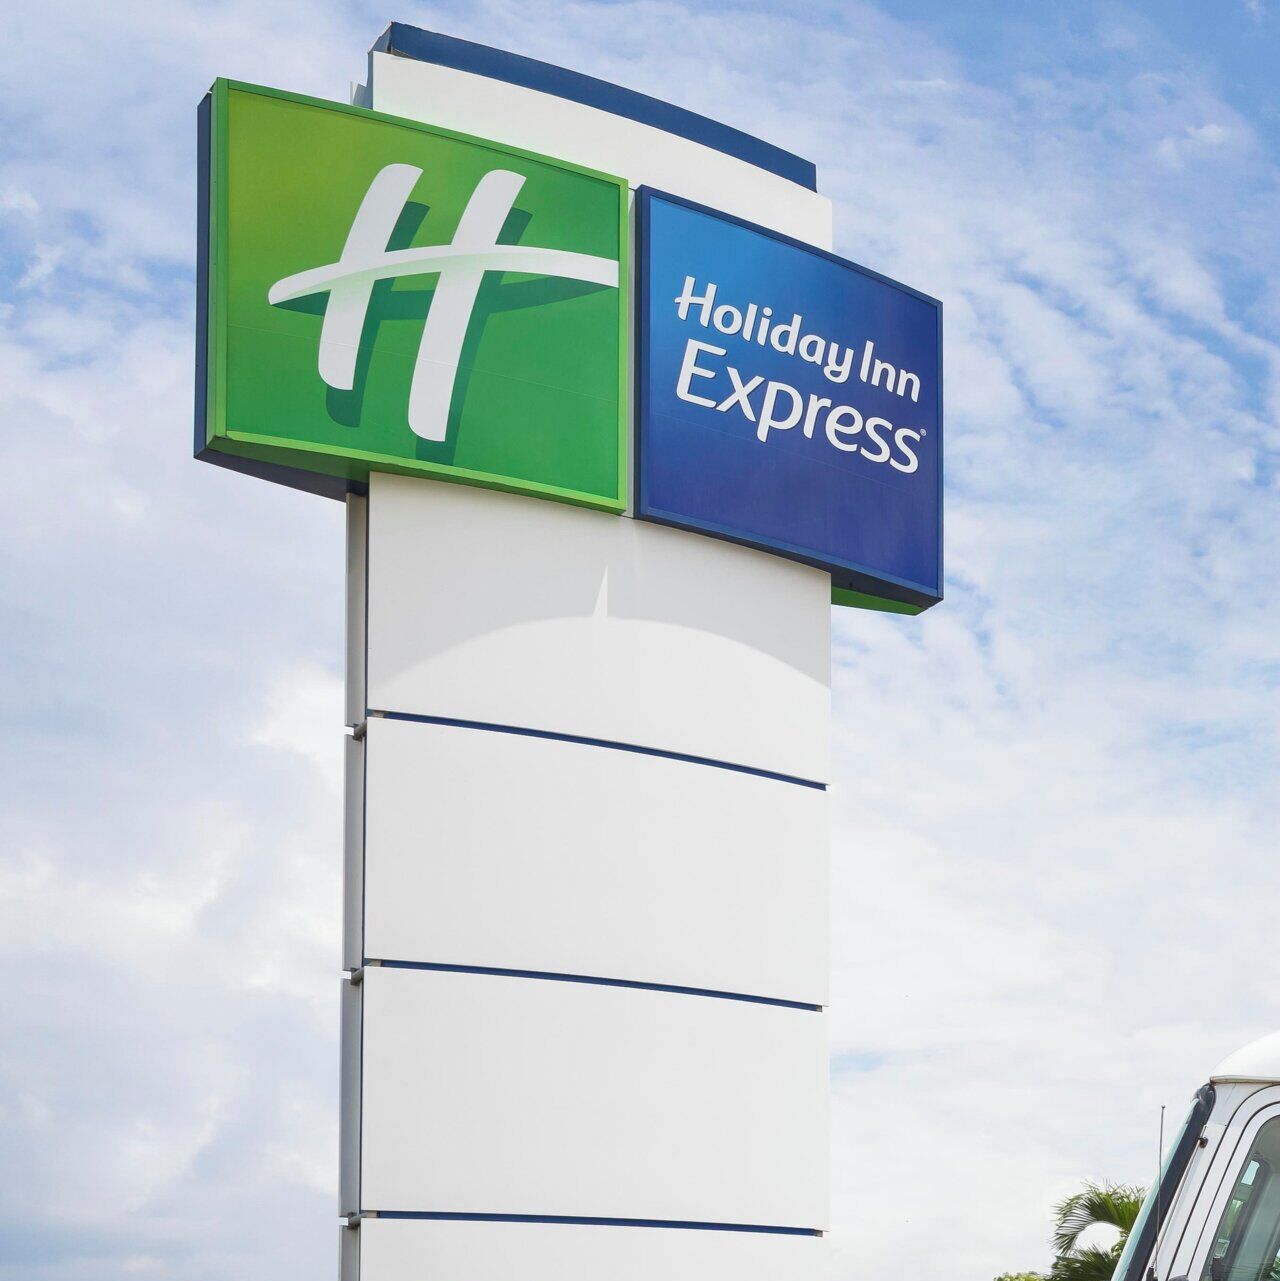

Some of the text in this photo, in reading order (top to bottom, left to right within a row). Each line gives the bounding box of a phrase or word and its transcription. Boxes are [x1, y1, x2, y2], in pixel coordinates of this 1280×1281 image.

[674, 275, 922, 403] Holiday Inn
[676, 338, 922, 474] Express
